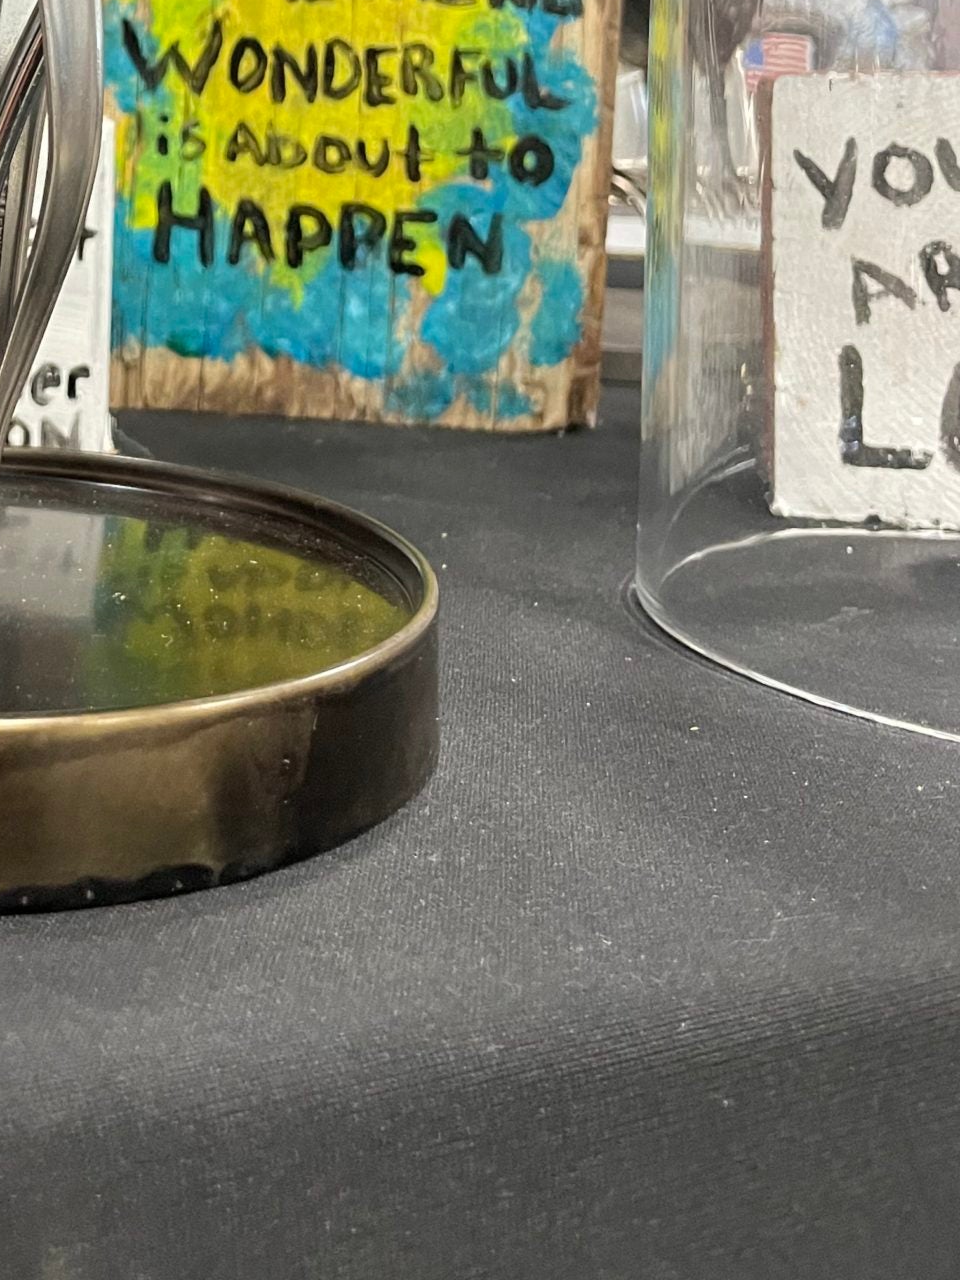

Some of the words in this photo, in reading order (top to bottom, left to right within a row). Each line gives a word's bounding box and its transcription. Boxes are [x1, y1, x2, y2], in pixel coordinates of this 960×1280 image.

[121, 18, 575, 109] WONDERFUL
[464, 126, 556, 184] to
[152, 181, 505, 277] HAPPEN
